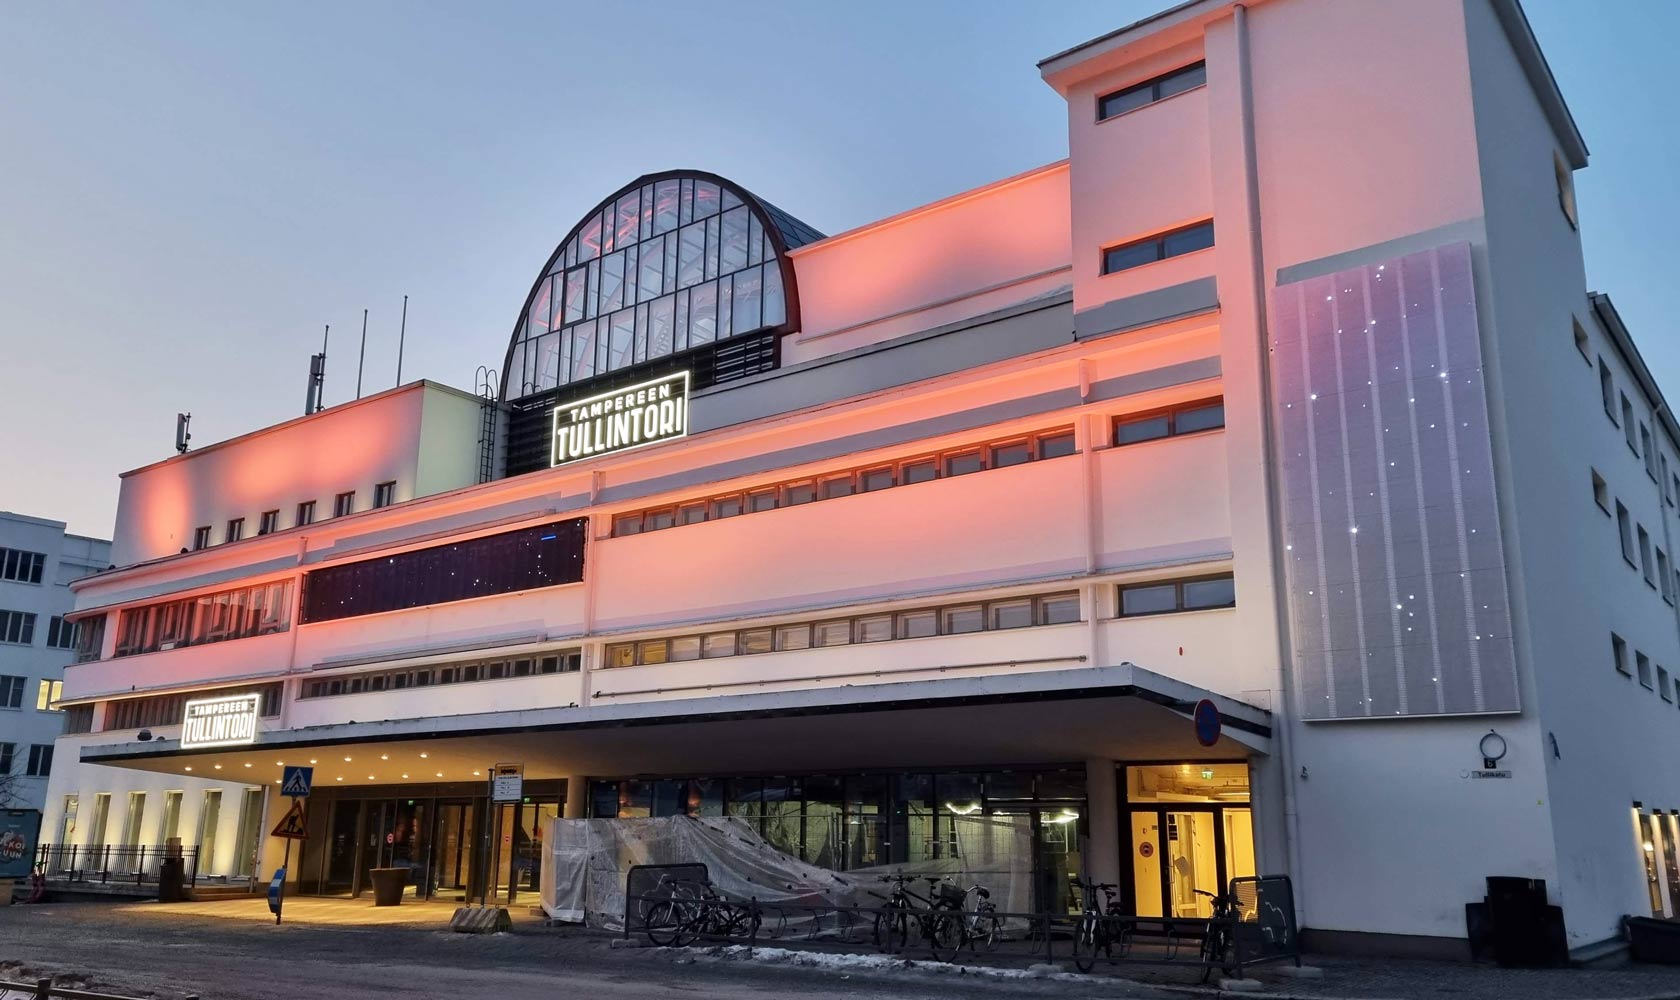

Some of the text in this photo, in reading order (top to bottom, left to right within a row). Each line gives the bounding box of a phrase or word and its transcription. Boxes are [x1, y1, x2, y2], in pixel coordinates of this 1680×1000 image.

[570, 384, 671, 422] TAMPEREEN
[557, 396, 683, 461] TULLINTORI
[194, 701, 249, 716] TAMPEREEN
[185, 712, 254, 742] TULLINTORI
